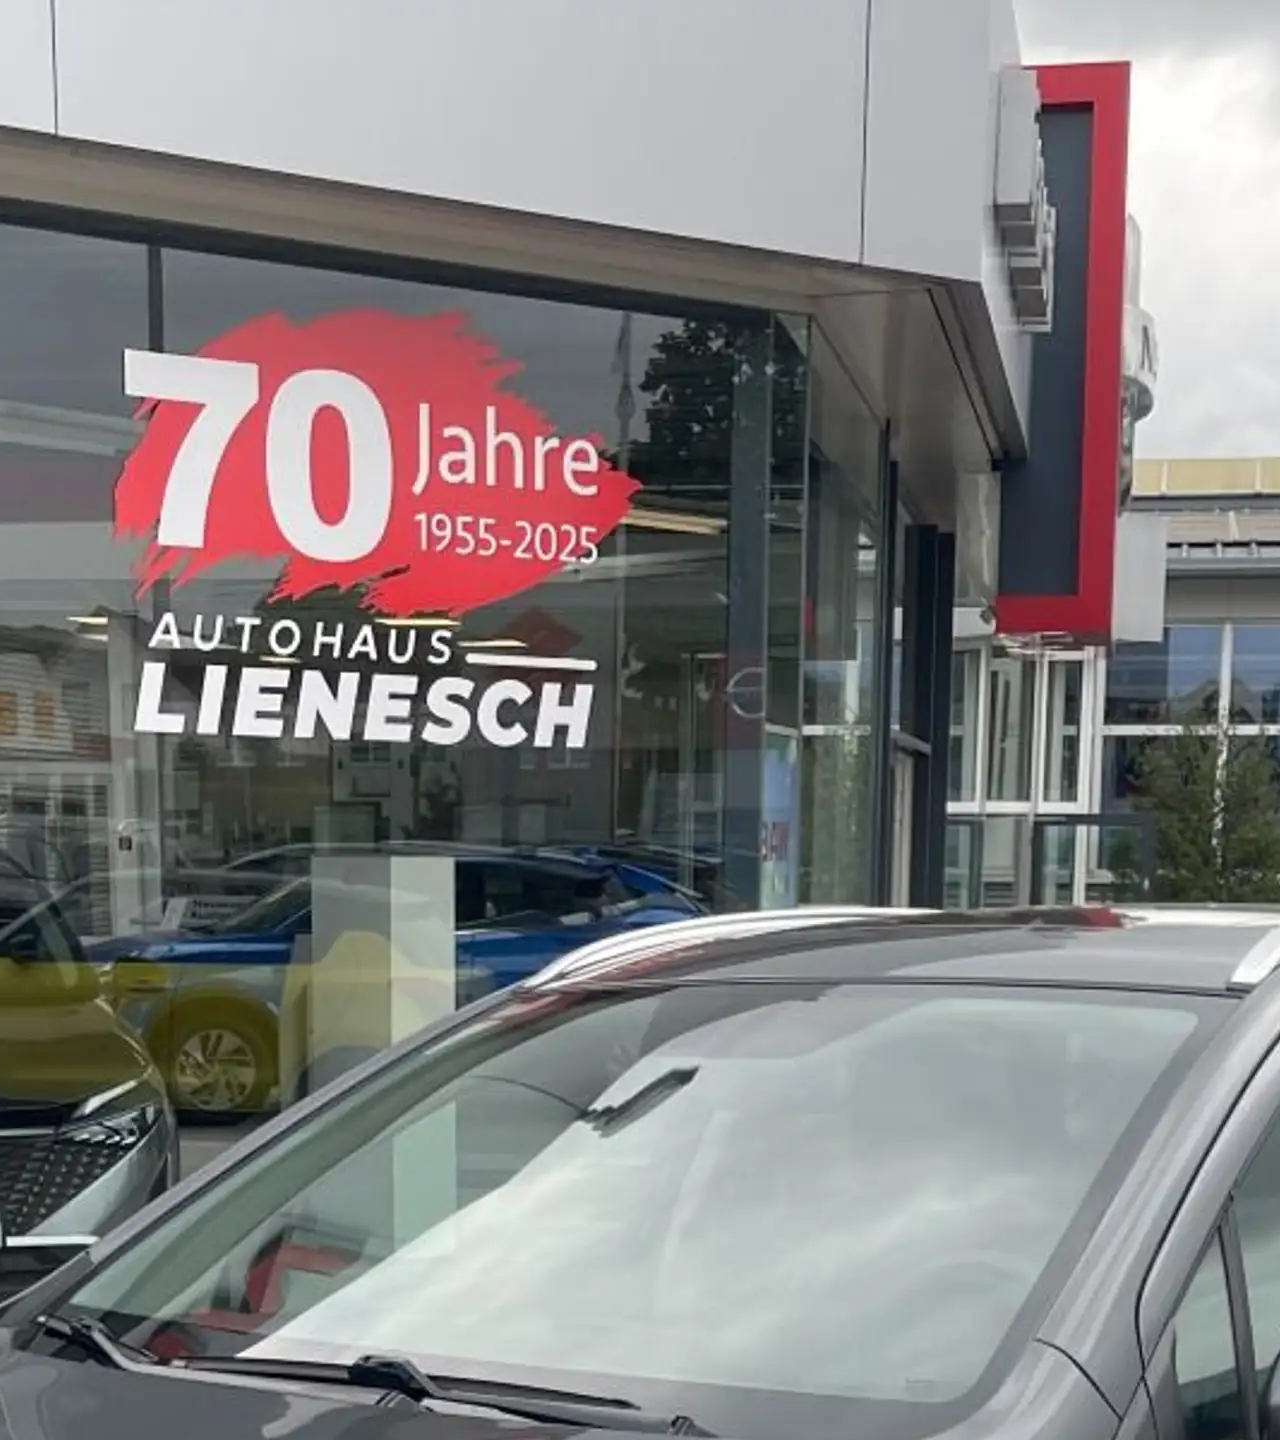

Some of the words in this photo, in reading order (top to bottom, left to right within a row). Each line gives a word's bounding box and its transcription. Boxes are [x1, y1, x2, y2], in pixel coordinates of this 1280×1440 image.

[124, 348, 394, 563] 70
[412, 402, 599, 496] Jahre
[414, 512, 598, 565] 1955-2025
[148, 611, 453, 665] AUTOHAUS
[134, 661, 594, 748] LIENESCH
